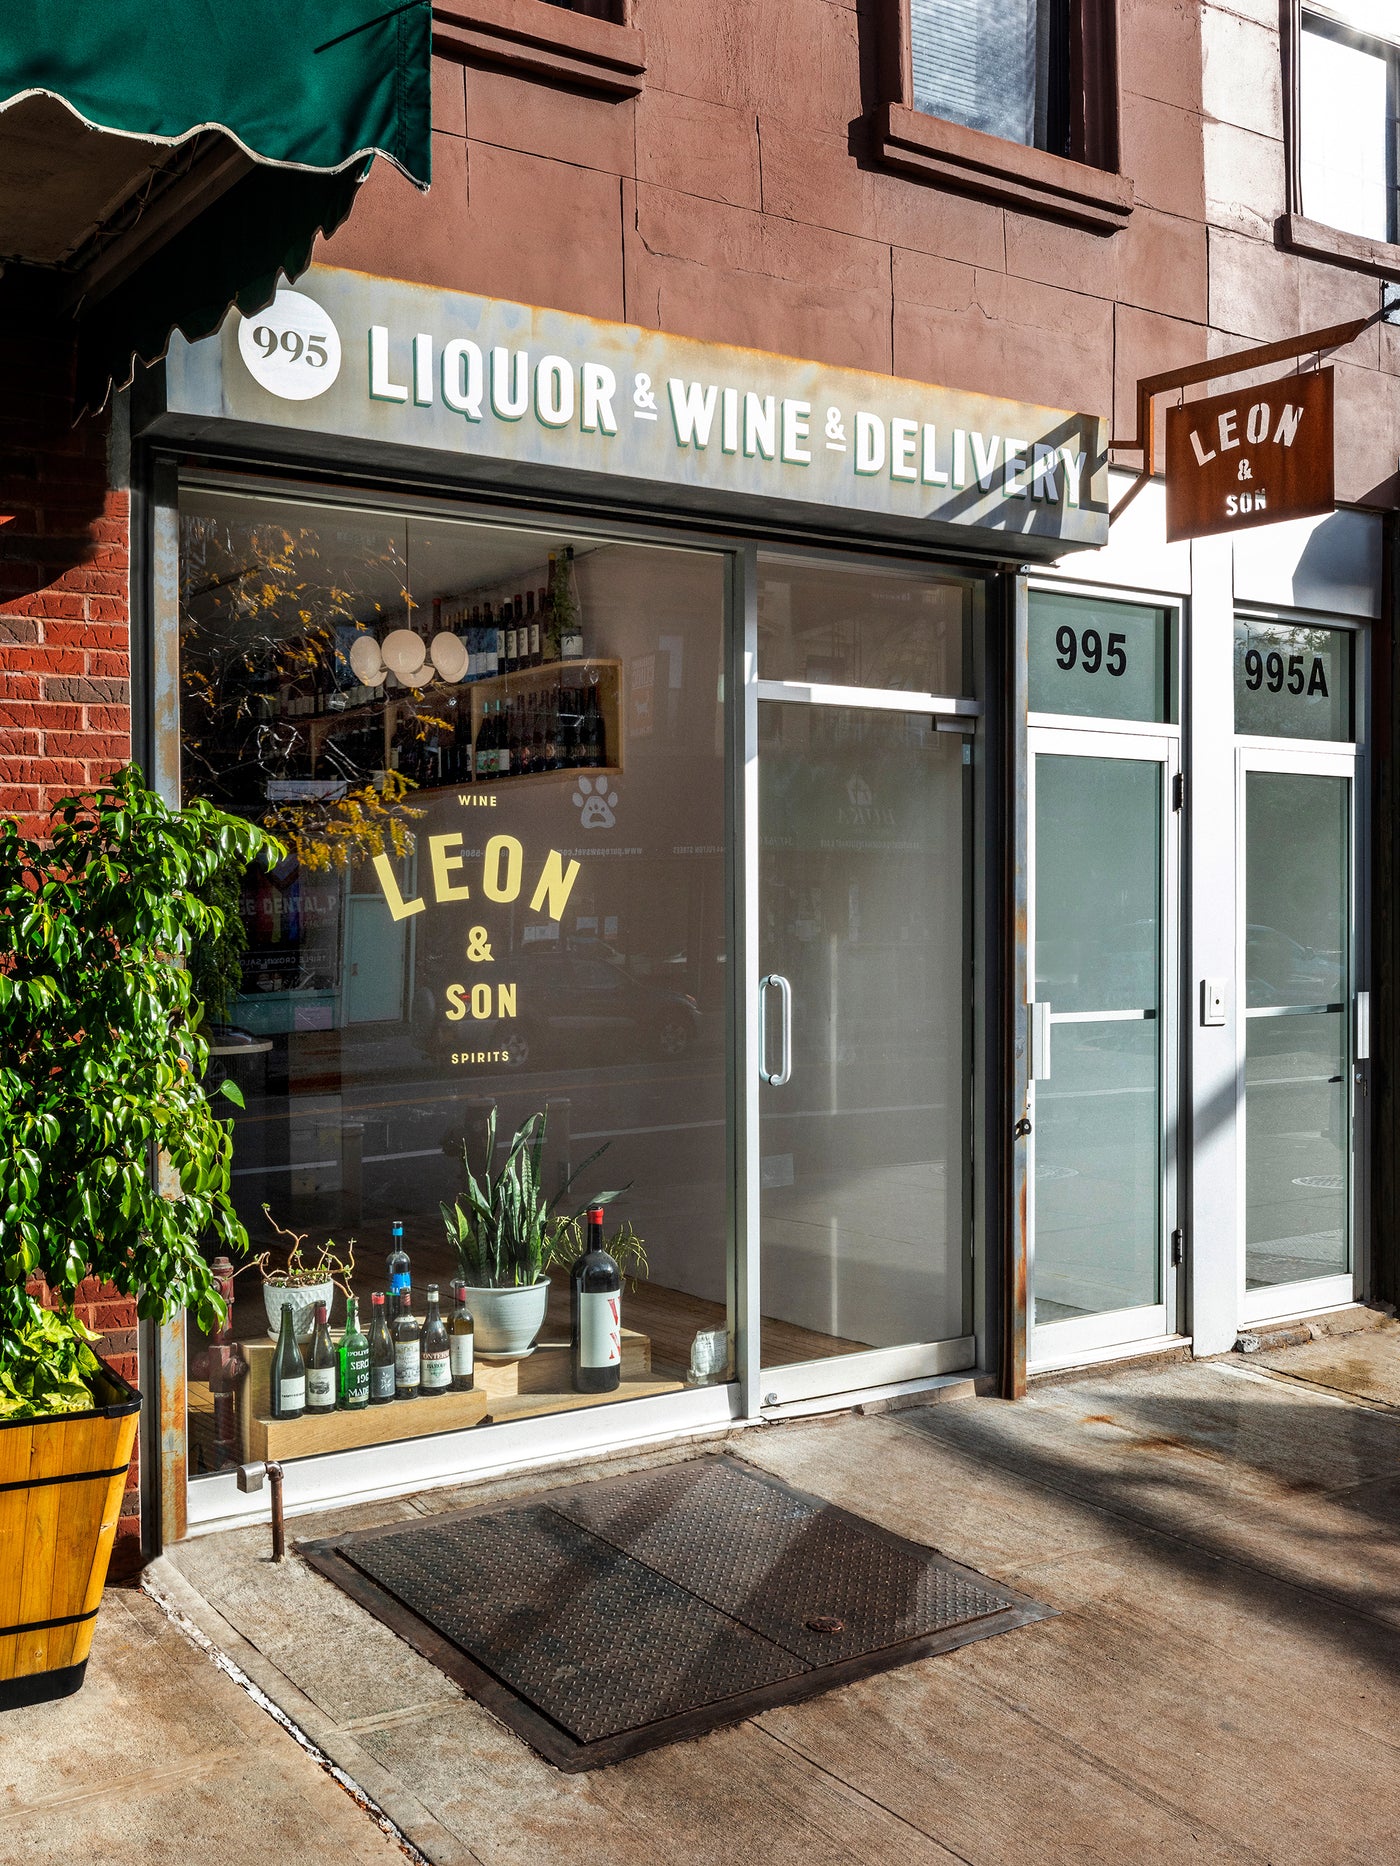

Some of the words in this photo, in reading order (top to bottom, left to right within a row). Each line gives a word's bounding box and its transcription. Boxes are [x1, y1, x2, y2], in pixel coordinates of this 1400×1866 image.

[252, 325, 328, 368] 995
[368, 325, 618, 437] LIQUOR
[631, 372, 658, 412] &
[667, 378, 812, 466] WINE
[825, 405, 847, 442] &
[853, 411, 1087, 508] DELIVERY
[1189, 402, 1304, 467] LEON
[1237, 458, 1253, 481] &
[1226, 488, 1267, 517] SON
[1055, 625, 1127, 677] 995
[1244, 649, 1329, 698] 995A
[458, 794, 497, 807] WINE
[372, 832, 581, 922] LEON
[466, 925, 495, 962] &
[445, 983, 517, 1021] SON
[451, 1051, 509, 1065] SPIRITS
